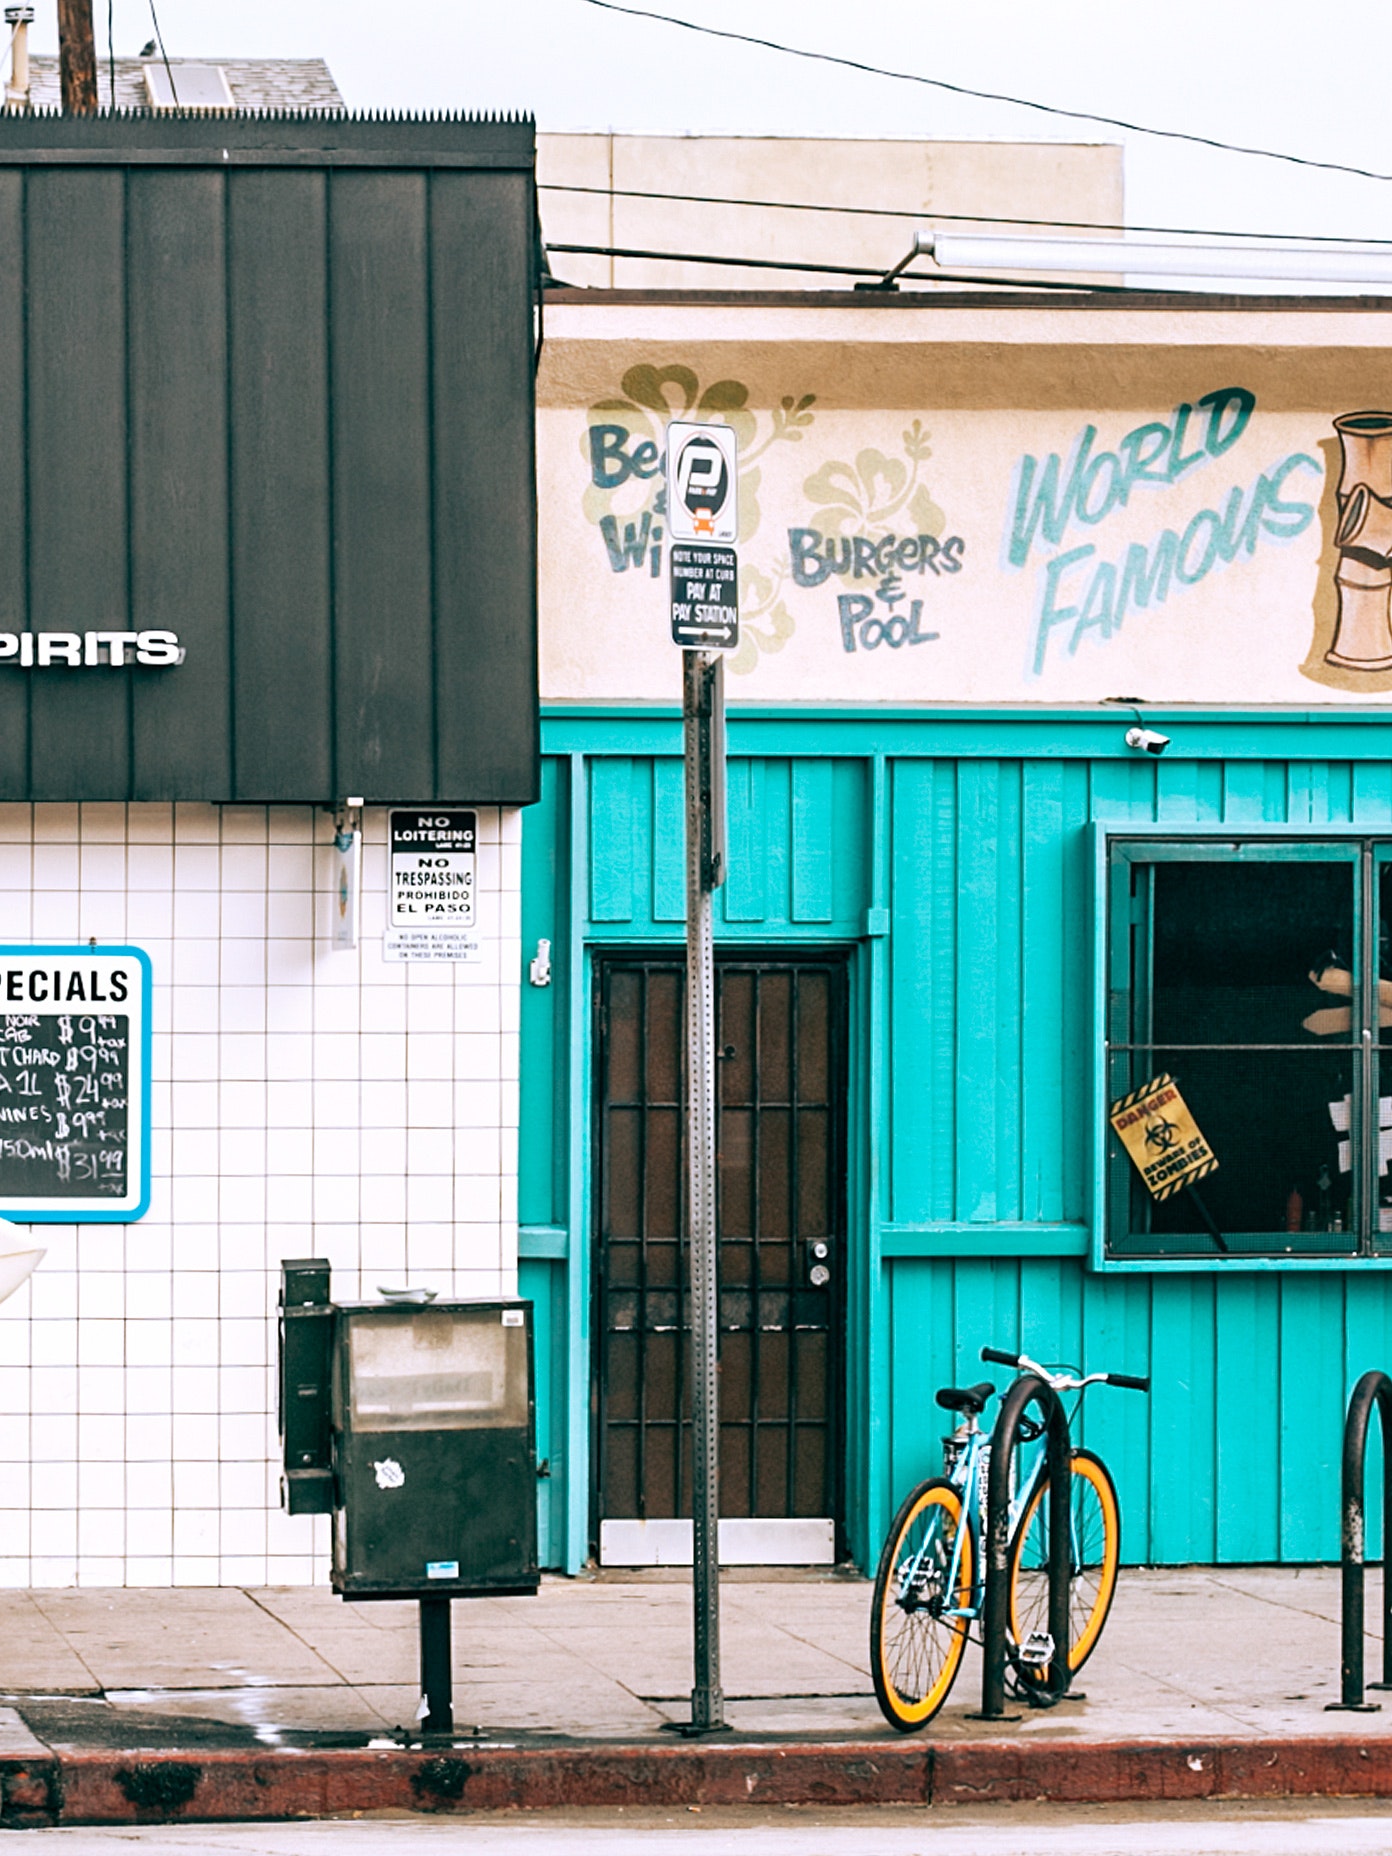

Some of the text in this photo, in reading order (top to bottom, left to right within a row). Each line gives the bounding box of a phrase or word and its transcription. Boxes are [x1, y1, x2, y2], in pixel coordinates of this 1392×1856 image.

[589, 424, 666, 489] Be
[1006, 386, 1256, 568] WORLD
[599, 511, 663, 578] Wi
[693, 552, 712, 564] YOUR
[713, 554, 734, 567] SPACE
[788, 528, 965, 587] BURGERS
[1030, 452, 1324, 677] FAMOUS
[705, 568, 714, 580] AT
[715, 569, 735, 581] CURB
[686, 581, 722, 602] PAY AT
[672, 603, 737, 626] PAY STATION
[837, 594, 940, 653] POOL
[417, 816, 450, 828] NO
[394, 830, 474, 842] LOITERING
[418, 858, 450, 868] NO
[395, 872, 473, 886] TRESPASSING
[397, 890, 470, 900] PROHIBIDO
[397, 903, 471, 913] EL PASO
[5, 1014, 41, 1027] NOIR
[12, 1046, 61, 1067] CHARD
[16, 1069, 43, 1096] 1L
[1115, 1088, 1177, 1131] DANGER
[1143, 1136, 1201, 1175] BEWARE OF
[1147, 1145, 1209, 1187] ZOMBIES
